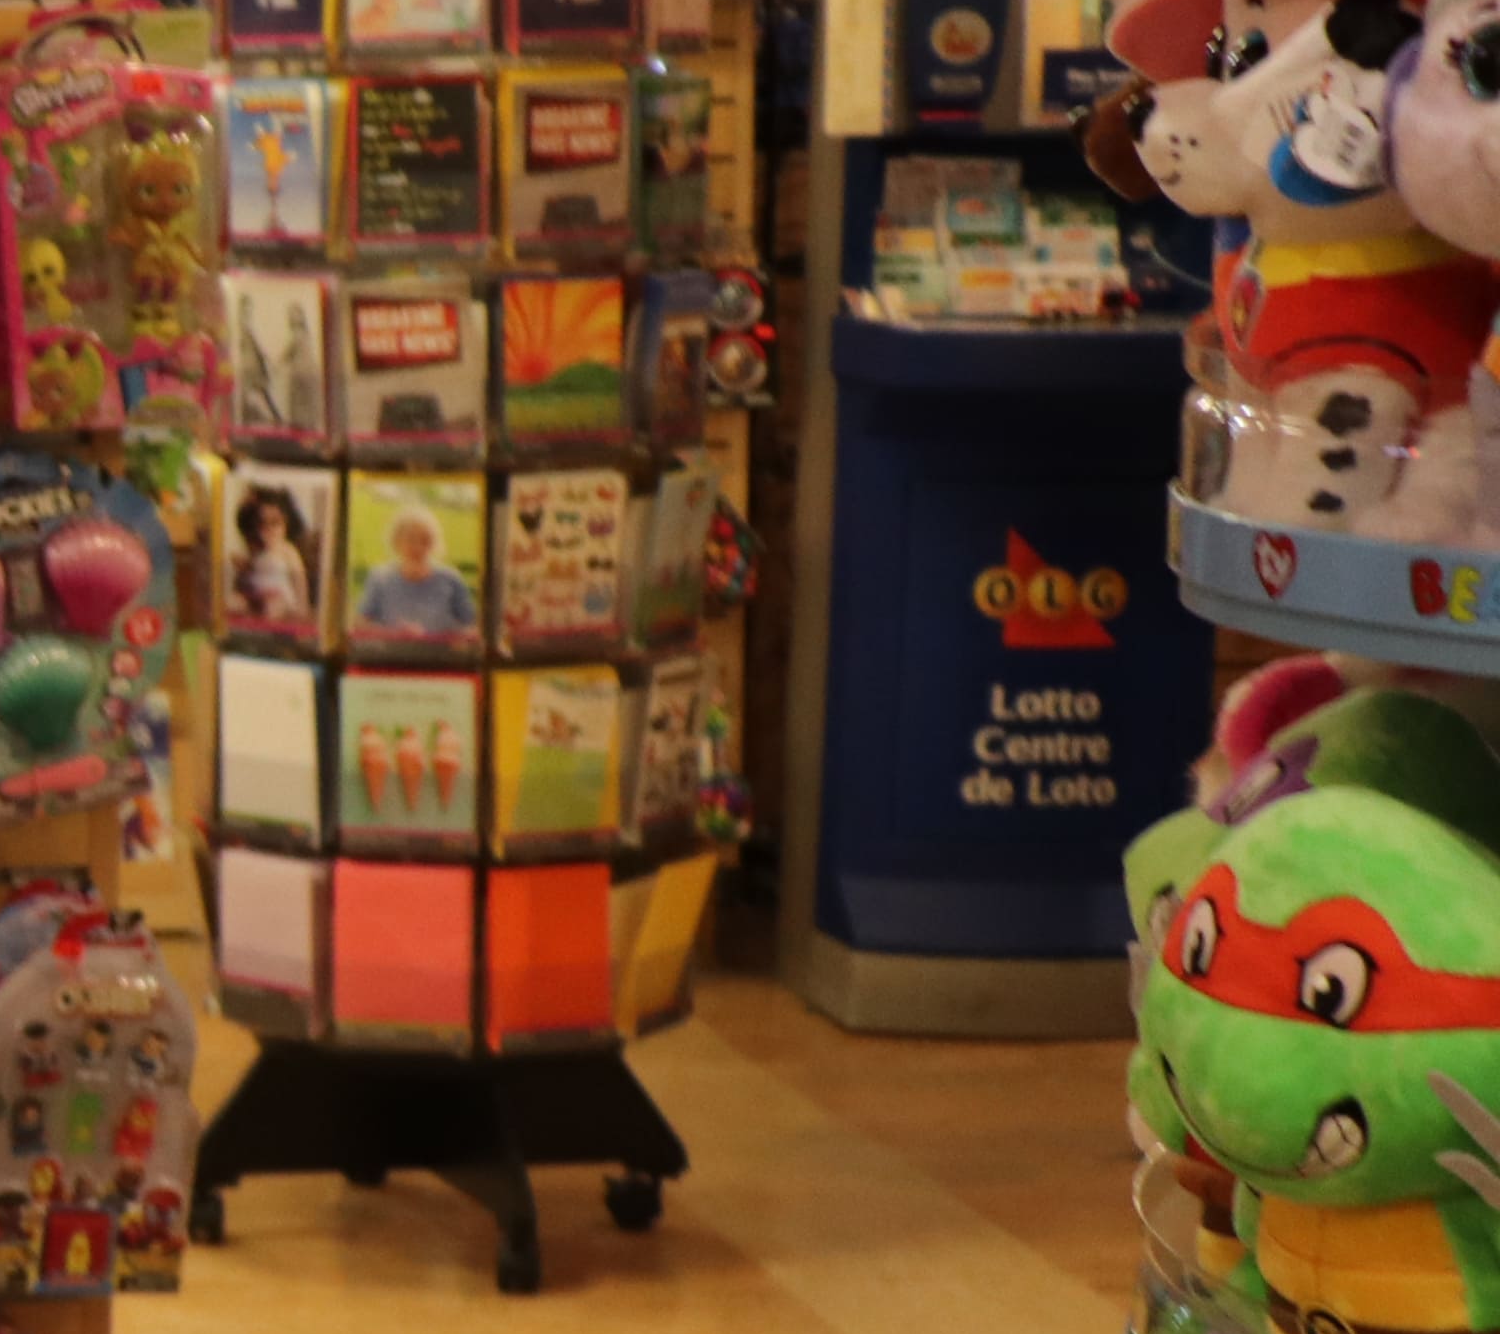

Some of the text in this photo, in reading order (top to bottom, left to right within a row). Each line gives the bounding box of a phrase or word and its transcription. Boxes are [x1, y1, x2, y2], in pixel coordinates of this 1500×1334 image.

[981, 571, 1124, 615] OLG
[991, 683, 1101, 721] Lotto
[973, 724, 1111, 763] Centre
[961, 768, 1117, 806] de Loto
